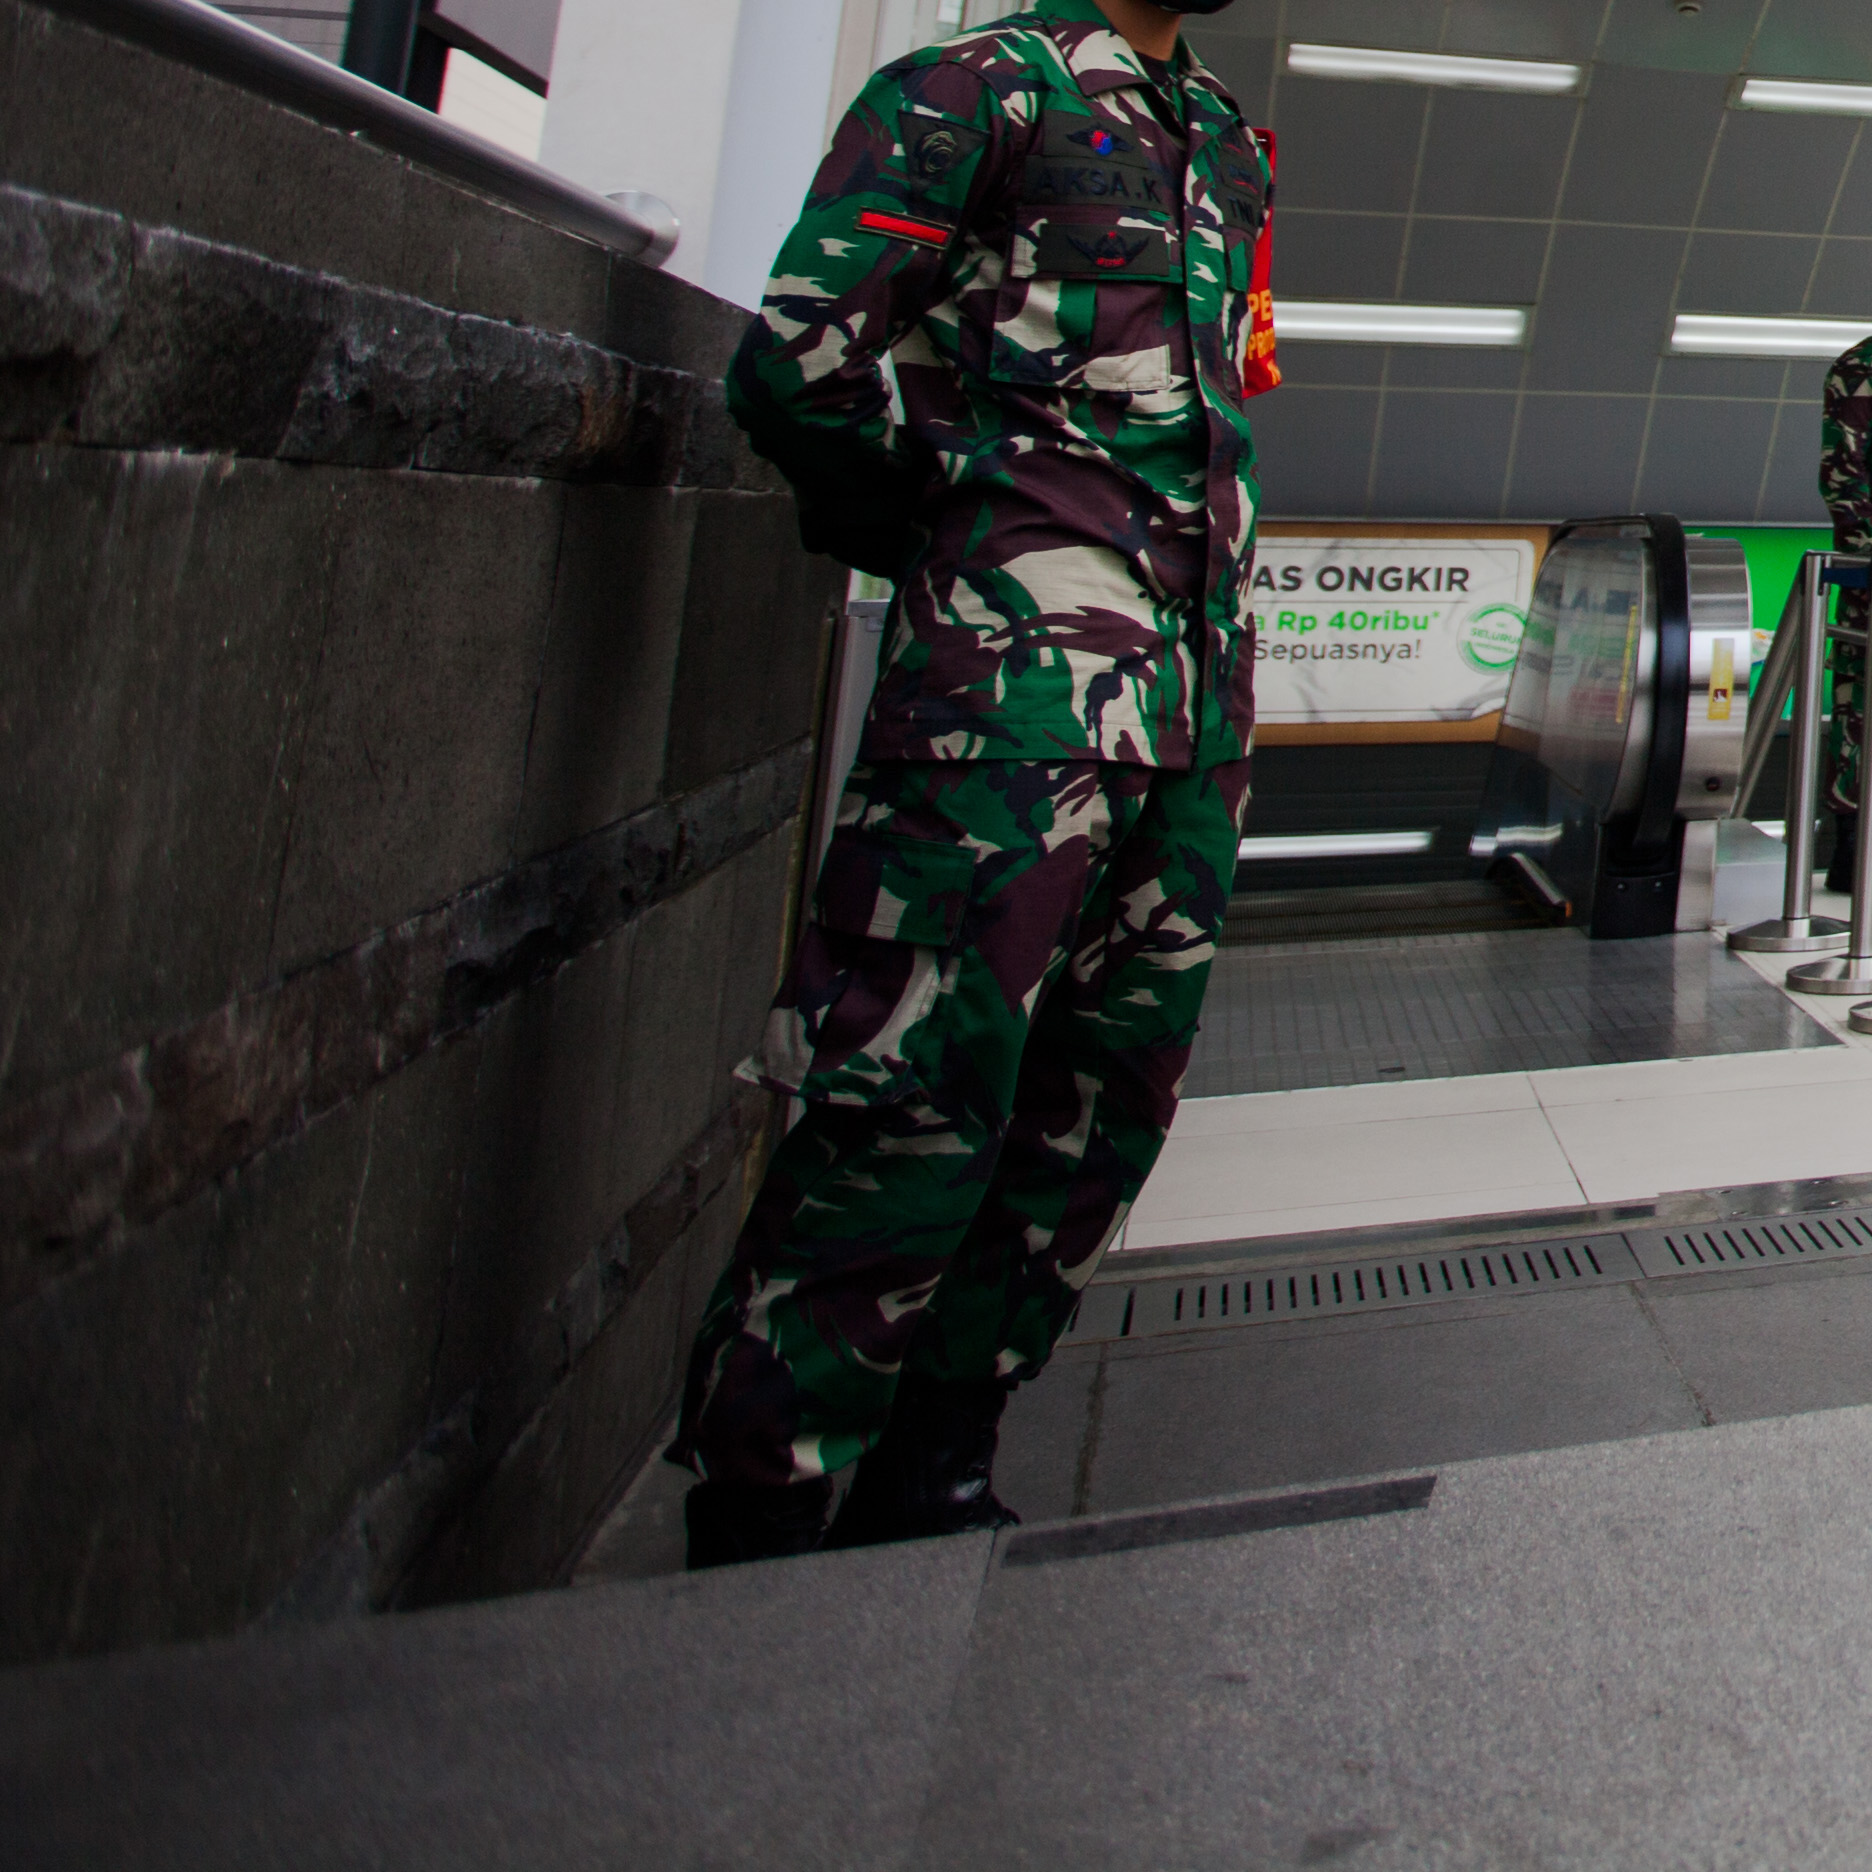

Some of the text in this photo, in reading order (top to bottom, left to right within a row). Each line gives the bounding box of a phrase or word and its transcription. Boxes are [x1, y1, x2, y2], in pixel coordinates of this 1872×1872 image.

[1253, 565, 1470, 593] AS ONGKIR
[1277, 610, 1318, 636] Rp
[1254, 638, 1421, 664] Sepuasnya!
